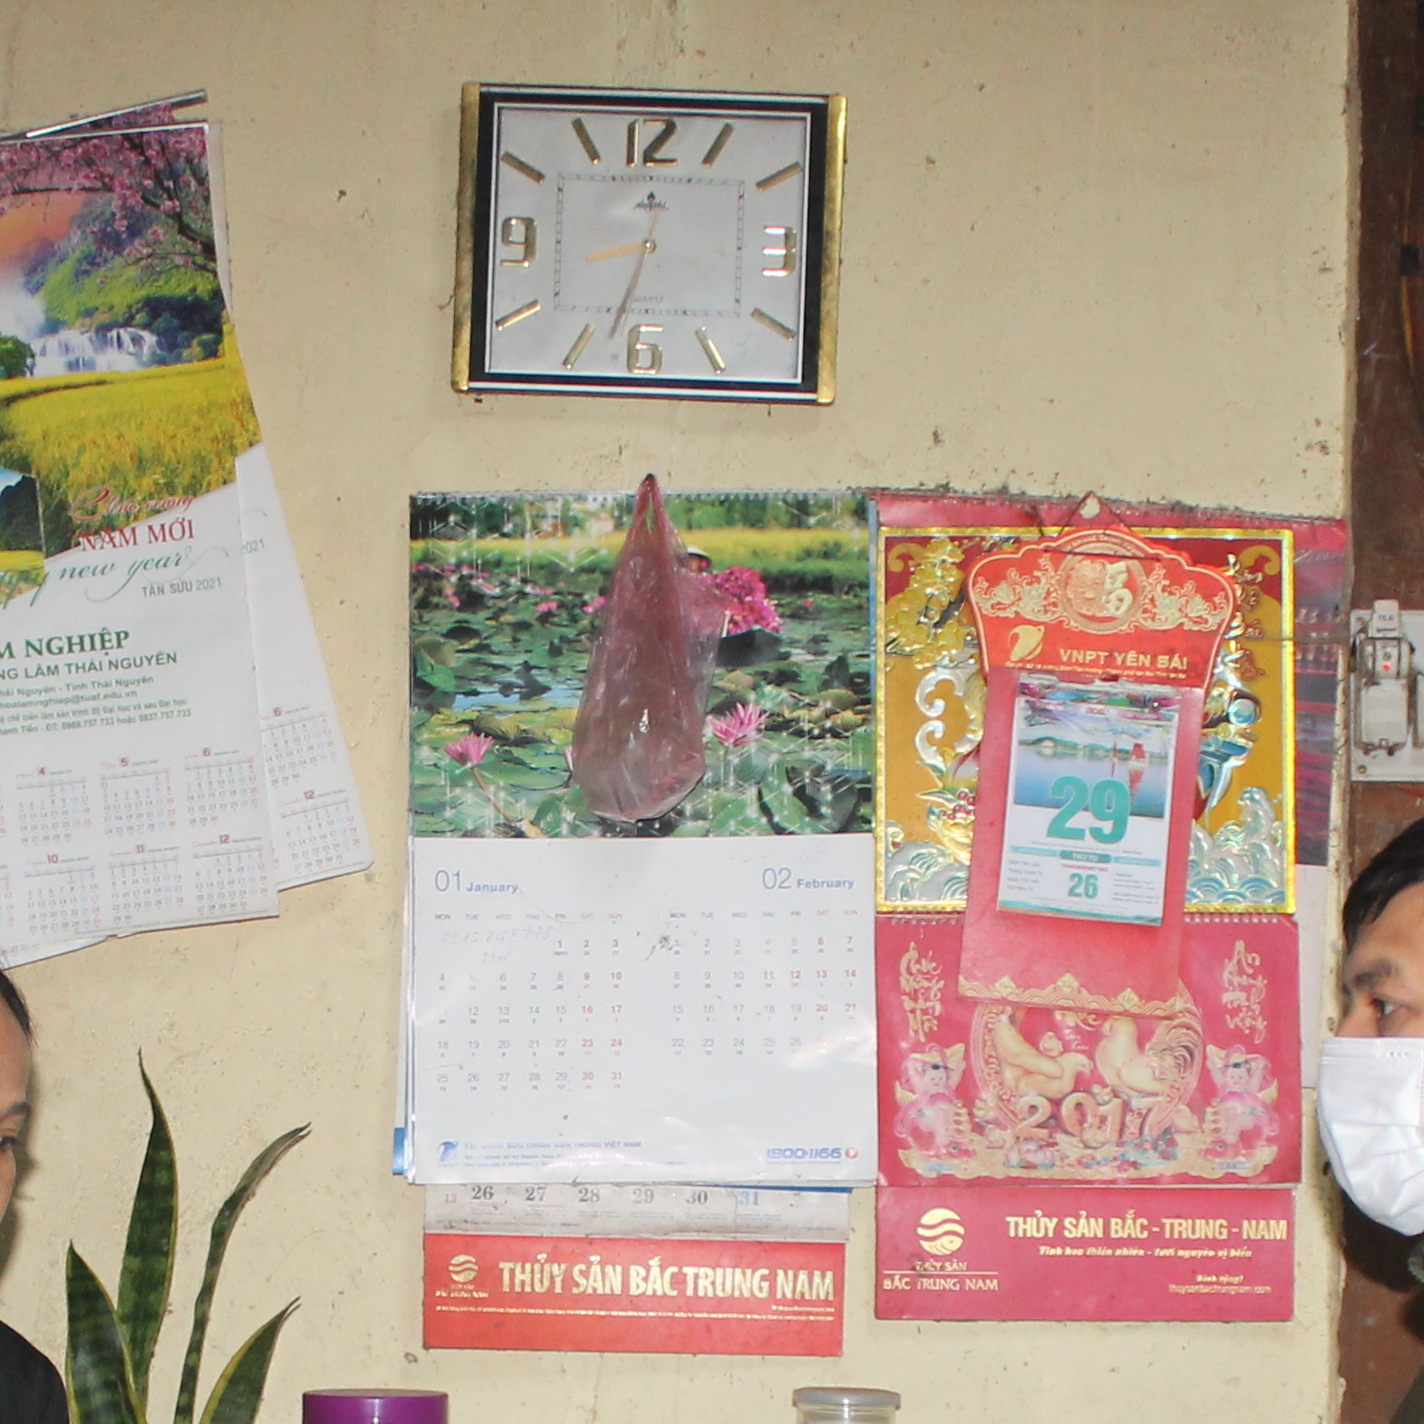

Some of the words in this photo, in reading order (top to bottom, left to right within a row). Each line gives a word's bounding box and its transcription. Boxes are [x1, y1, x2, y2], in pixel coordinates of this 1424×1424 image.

[626, 118, 678, 167] 12
[500, 216, 538, 267] 9
[761, 225, 797, 277] 3
[627, 324, 664, 375] 6
[148, 516, 195, 544] MỚI
[58, 562, 116, 580] new
[195, 577, 222, 592] 2021
[25, 627, 130, 658] NGHIỆP
[24, 662, 60, 680] LÂM
[65, 658, 104, 676] THÁI
[108, 651, 177, 671] NGUYÊN
[1059, 648, 1109, 666] VNPT
[1114, 650, 1152, 668] YÊN
[1047, 775, 1131, 844] 29
[434, 869, 462, 892] 01
[466, 880, 519, 893] January
[762, 867, 792, 890] 02
[797, 877, 855, 890] February
[1068, 873, 1099, 898] 26
[471, 1185, 494, 1201] 26
[525, 1185, 548, 1202] 27
[578, 1186, 601, 1203] 28
[632, 1188, 655, 1204] 29
[685, 1189, 709, 1206] 30
[738, 1190, 761, 1207] 31
[1006, 1210, 1058, 1238] THỦY
[1064, 1211, 1103, 1238] SẢN
[1110, 1209, 1149, 1239] BẮC
[1162, 1218, 1228, 1240] TRUNG
[1242, 1219, 1287, 1240] NAM
[499, 1253, 567, 1295] THỦY
[571, 1255, 623, 1296] SẢN
[629, 1256, 679, 1298] BẮC
[682, 1267, 770, 1299] TRUNG
[777, 1270, 834, 1300] NAM
[883, 1274, 911, 1290] BẮC
[917, 1277, 960, 1291] TRUNG
[965, 1278, 999, 1291] NAM
